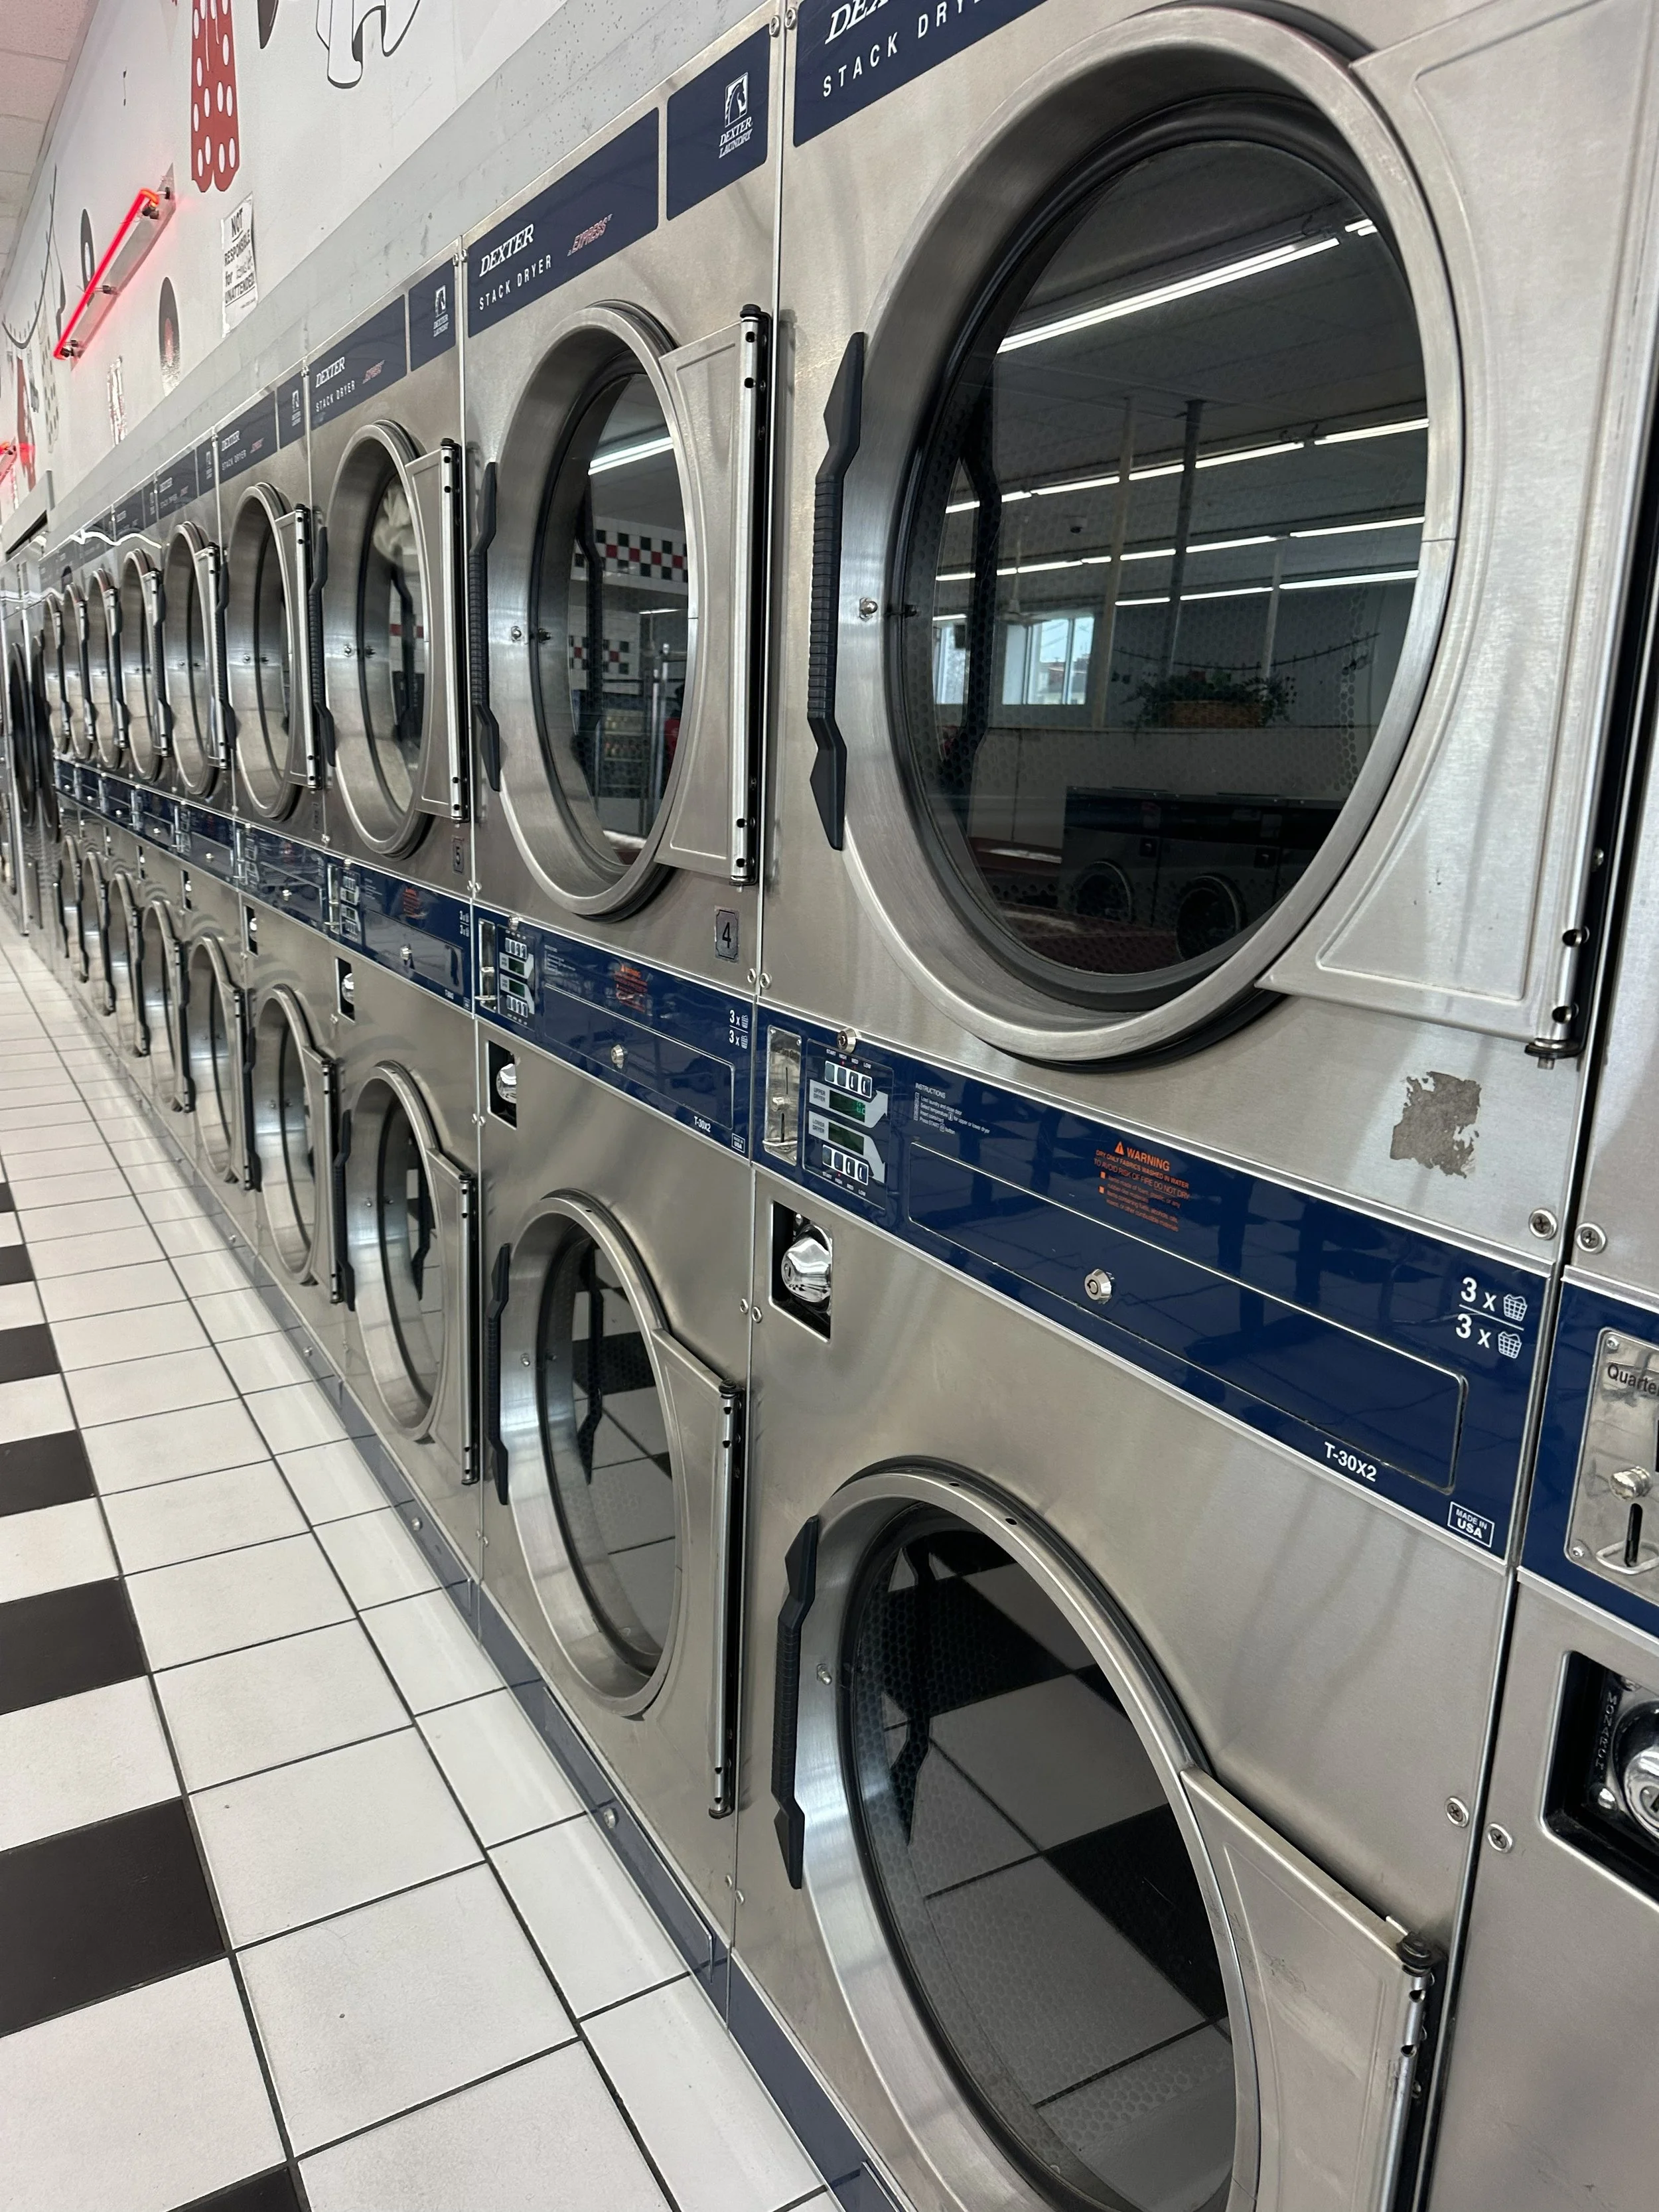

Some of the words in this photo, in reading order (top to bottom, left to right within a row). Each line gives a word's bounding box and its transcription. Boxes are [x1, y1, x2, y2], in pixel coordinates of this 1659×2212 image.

[823, 32, 898, 97] STACK
[719, 117, 752, 147] DEXTER
[719, 128, 753, 159] LAUNDRY
[231, 207, 243, 238] NOT
[479, 224, 534, 277] DEXTER
[569, 216, 611, 254] EXPRESS
[479, 279, 511, 311] STACK
[517, 254, 551, 287] DRYER
[315, 356, 345, 388] DEXTER
[316, 394, 334, 412] STACK
[336, 380, 355, 400] DRYER
[456, 846, 461, 865] 5
[722, 922, 732, 948] 4
[730, 1009, 735, 1023] 3
[736, 1016, 741, 1026] x
[729, 1030, 735, 1043] 3
[735, 1036, 740, 1047] x
[916, 1082, 946, 1099] INSTRUCTIONS
[693, 1116, 711, 1133] T-30X2
[1096, 1149, 1106, 1159] DRY
[1106, 1153, 1119, 1163] ONLY
[1119, 1159, 1141, 1171] FABRICS
[1141, 1166, 1164, 1179] WASHED
[1170, 1177, 1189, 1189] WATER
[1127, 1147, 1171, 1172] WARNING
[1094, 1157, 1102, 1167] TO
[1102, 1161, 1118, 1173] AVOID
[1141, 1175, 1153, 1186] FIRE
[1154, 1181, 1163, 1190] DO
[1163, 1185, 1177, 1195] NOT
[1461, 1277, 1477, 1303] 3
[1482, 1291, 1497, 1312] x
[1455, 1313, 1472, 1339] 3
[1477, 1328, 1492, 1349] x
[1607, 1363, 1659, 1397] Quarte
[1324, 1441, 1378, 1483] T-30X2
[1456, 1509, 1478, 1526] MADE
[1479, 1520, 1488, 1530] IN
[1457, 1518, 1483, 1539] USA
